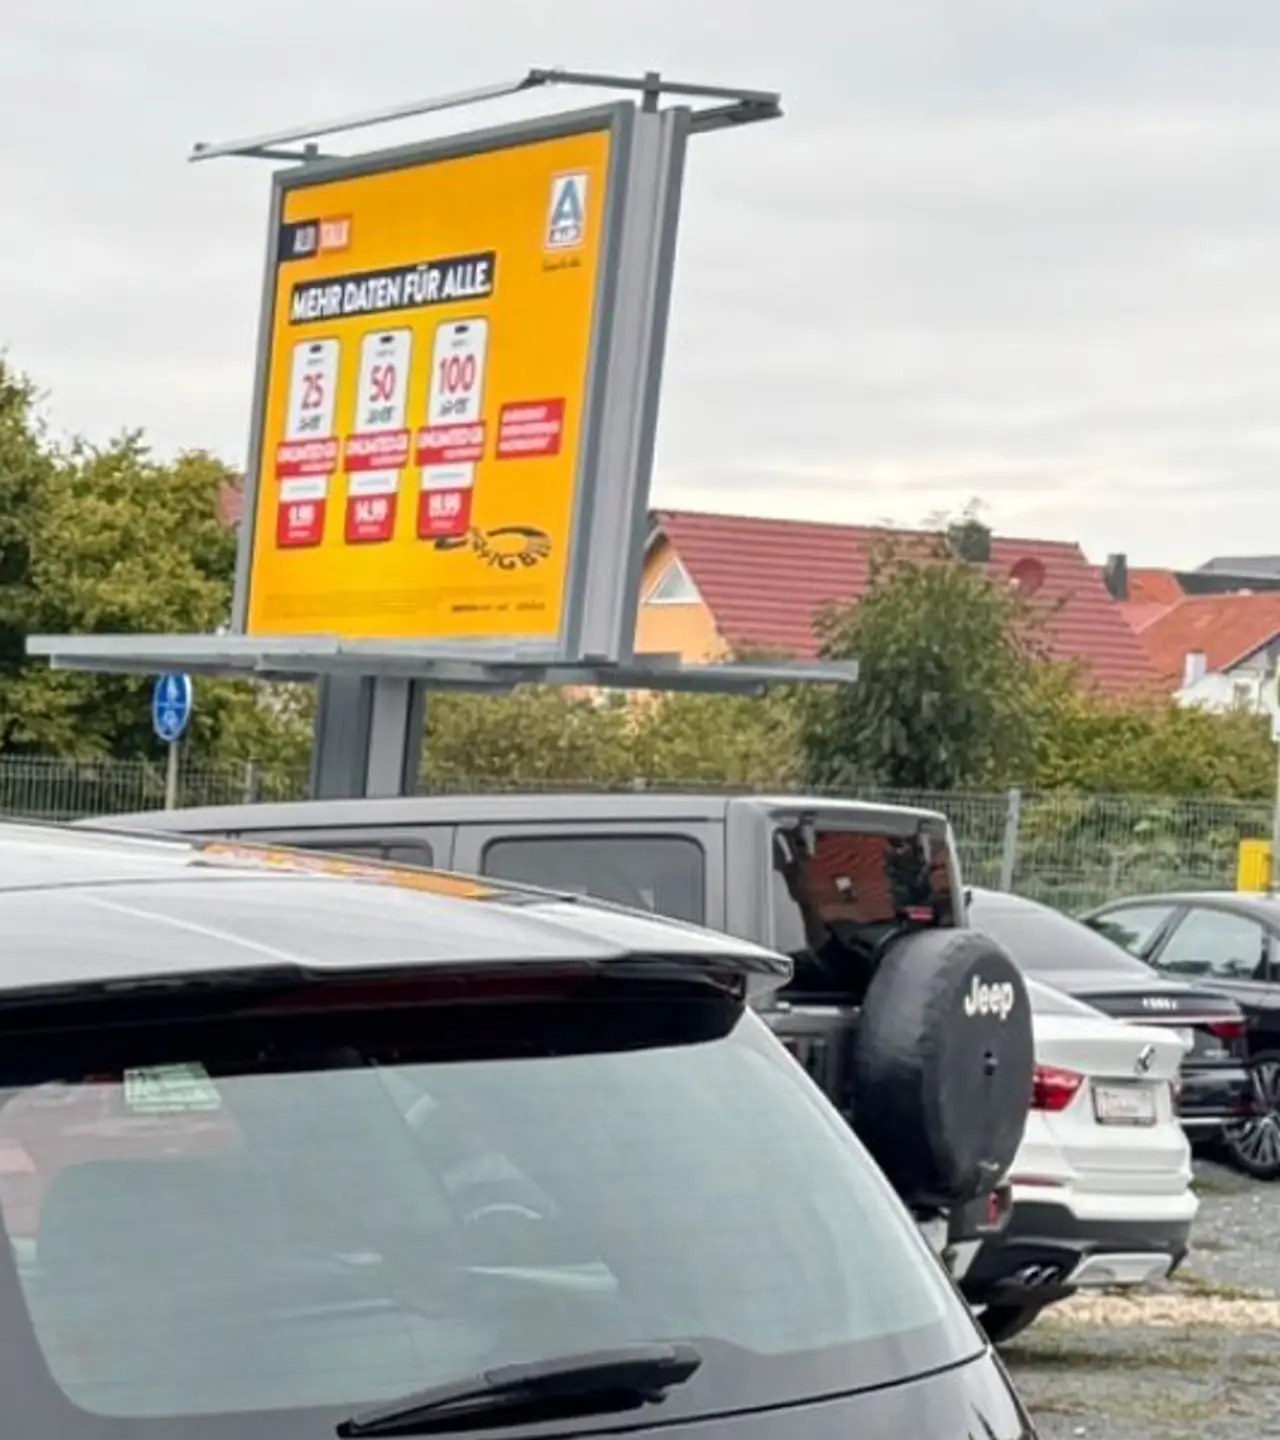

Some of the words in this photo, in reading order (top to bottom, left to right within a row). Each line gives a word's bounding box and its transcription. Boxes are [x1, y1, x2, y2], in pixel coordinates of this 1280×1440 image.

[292, 284, 342, 320] MEHR
[343, 273, 400, 312] DATEN
[402, 263, 439, 306] FÜR
[301, 373, 324, 411] 25
[369, 363, 397, 403] 50
[439, 354, 476, 396] 100
[964, 974, 1014, 1021] Jeep
